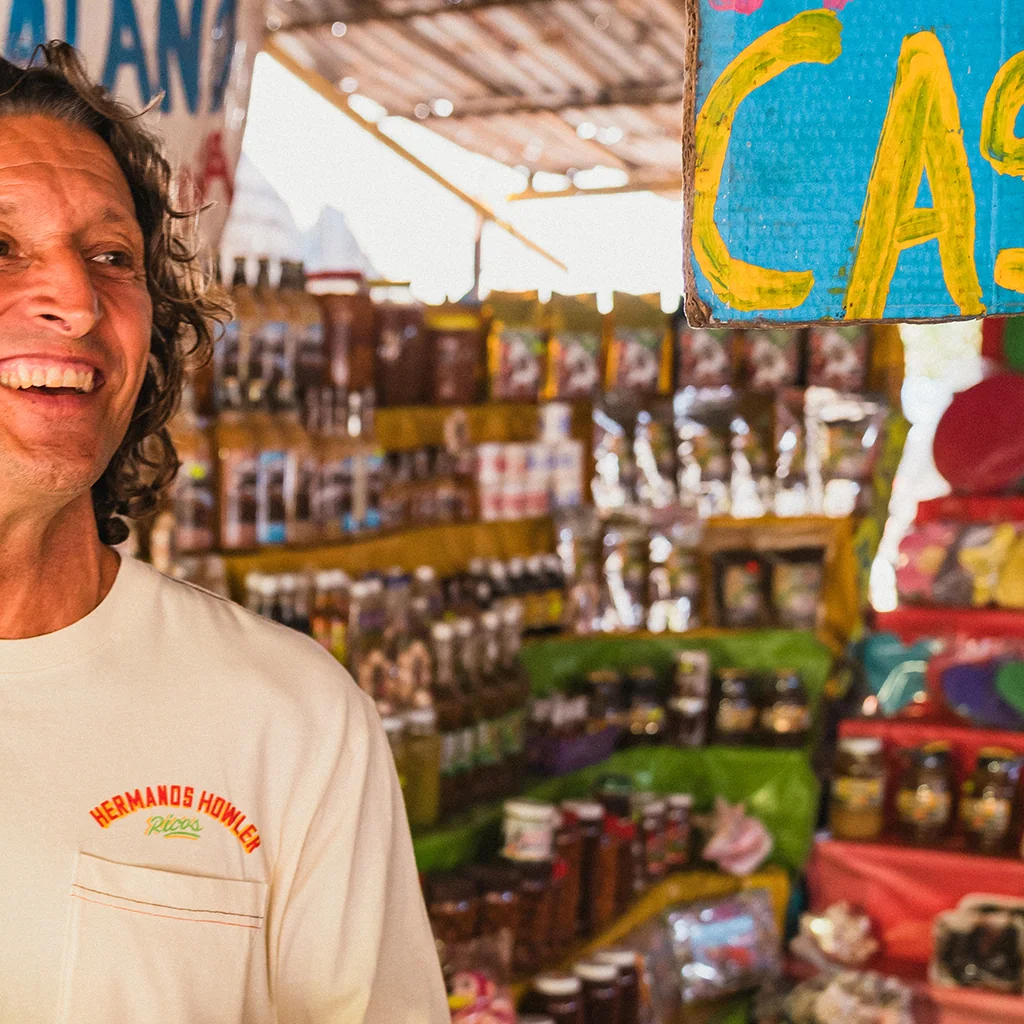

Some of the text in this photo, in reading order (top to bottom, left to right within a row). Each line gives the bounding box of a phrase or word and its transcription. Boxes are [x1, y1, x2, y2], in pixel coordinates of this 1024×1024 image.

[89, 784, 262, 854] HERMANOS HOWLER
[143, 813, 204, 838] Ricos
